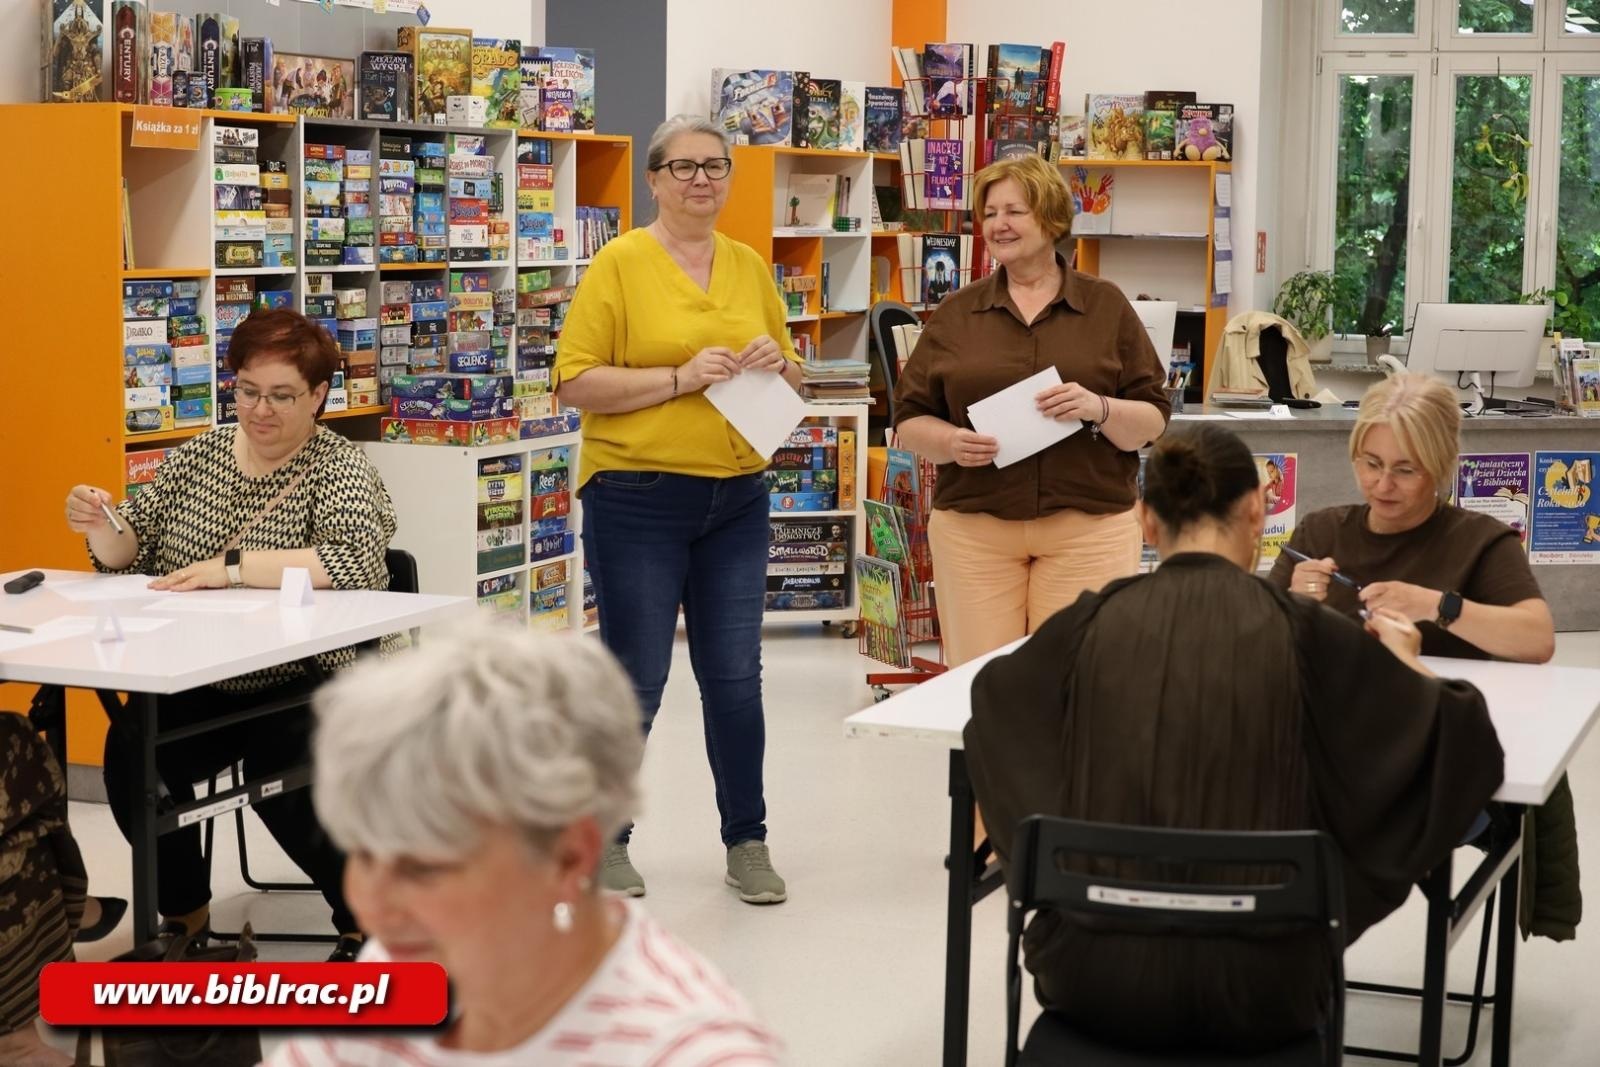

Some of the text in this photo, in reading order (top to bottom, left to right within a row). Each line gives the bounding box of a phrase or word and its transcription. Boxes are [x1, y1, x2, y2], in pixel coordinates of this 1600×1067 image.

[119, 27, 135, 82] CENTURY
[369, 56, 407, 64] ZAKAZANA
[204, 40, 218, 91] CENTURY
[371, 63, 406, 73] WYSPA
[136, 119, 199, 136] Książka za 1 zł
[928, 142, 961, 154] INACZEJ
[926, 236, 956, 249] WEDNESDAY
[127, 326, 153, 339] DRAKO
[457, 354, 488, 367] SEQUENCE
[1474, 460, 1526, 469] Fantastyczny
[1473, 467, 1528, 478] Dzień Dziecka
[539, 476, 556, 490] Reef
[1483, 478, 1523, 487] Biblioteką
[1261, 523, 1286, 535] uduj
